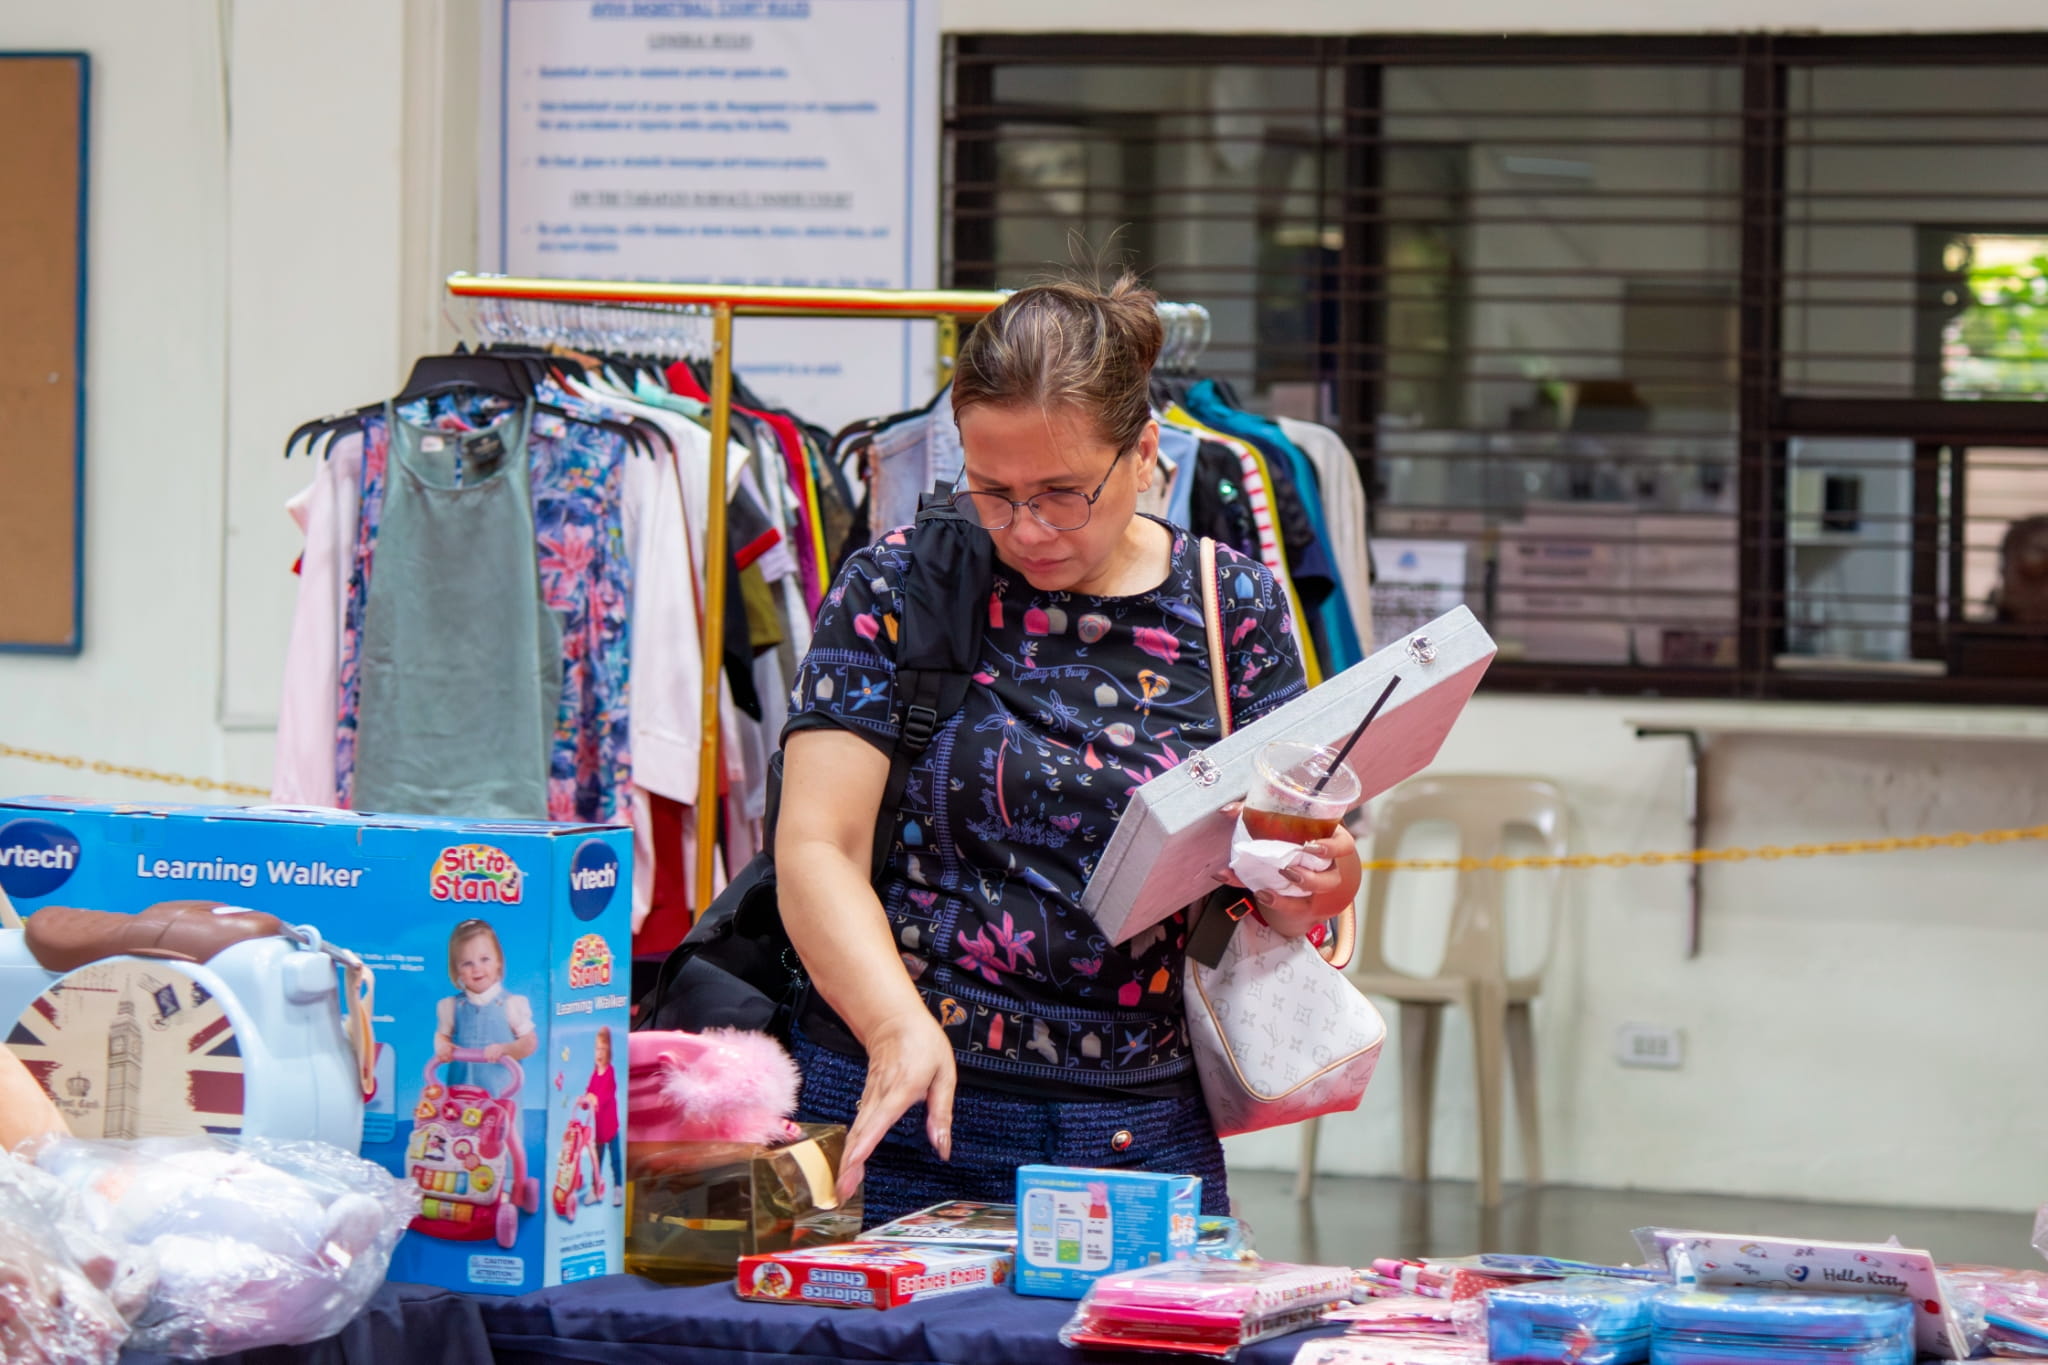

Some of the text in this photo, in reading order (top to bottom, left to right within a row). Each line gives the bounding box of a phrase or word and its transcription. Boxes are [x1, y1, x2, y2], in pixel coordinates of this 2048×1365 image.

[0, 844, 74, 870] vtech
[137, 854, 363, 888] Learning Walker
[571, 862, 616, 891] vtech
[431, 871, 521, 904] Stand
[555, 995, 628, 1016] Learning Walker
[809, 1268, 867, 1287] Chairs
[897, 1265, 987, 1296] Balance Chairs
[1823, 1268, 1909, 1292] Hello Kitty
[803, 1284, 875, 1304] Balance
